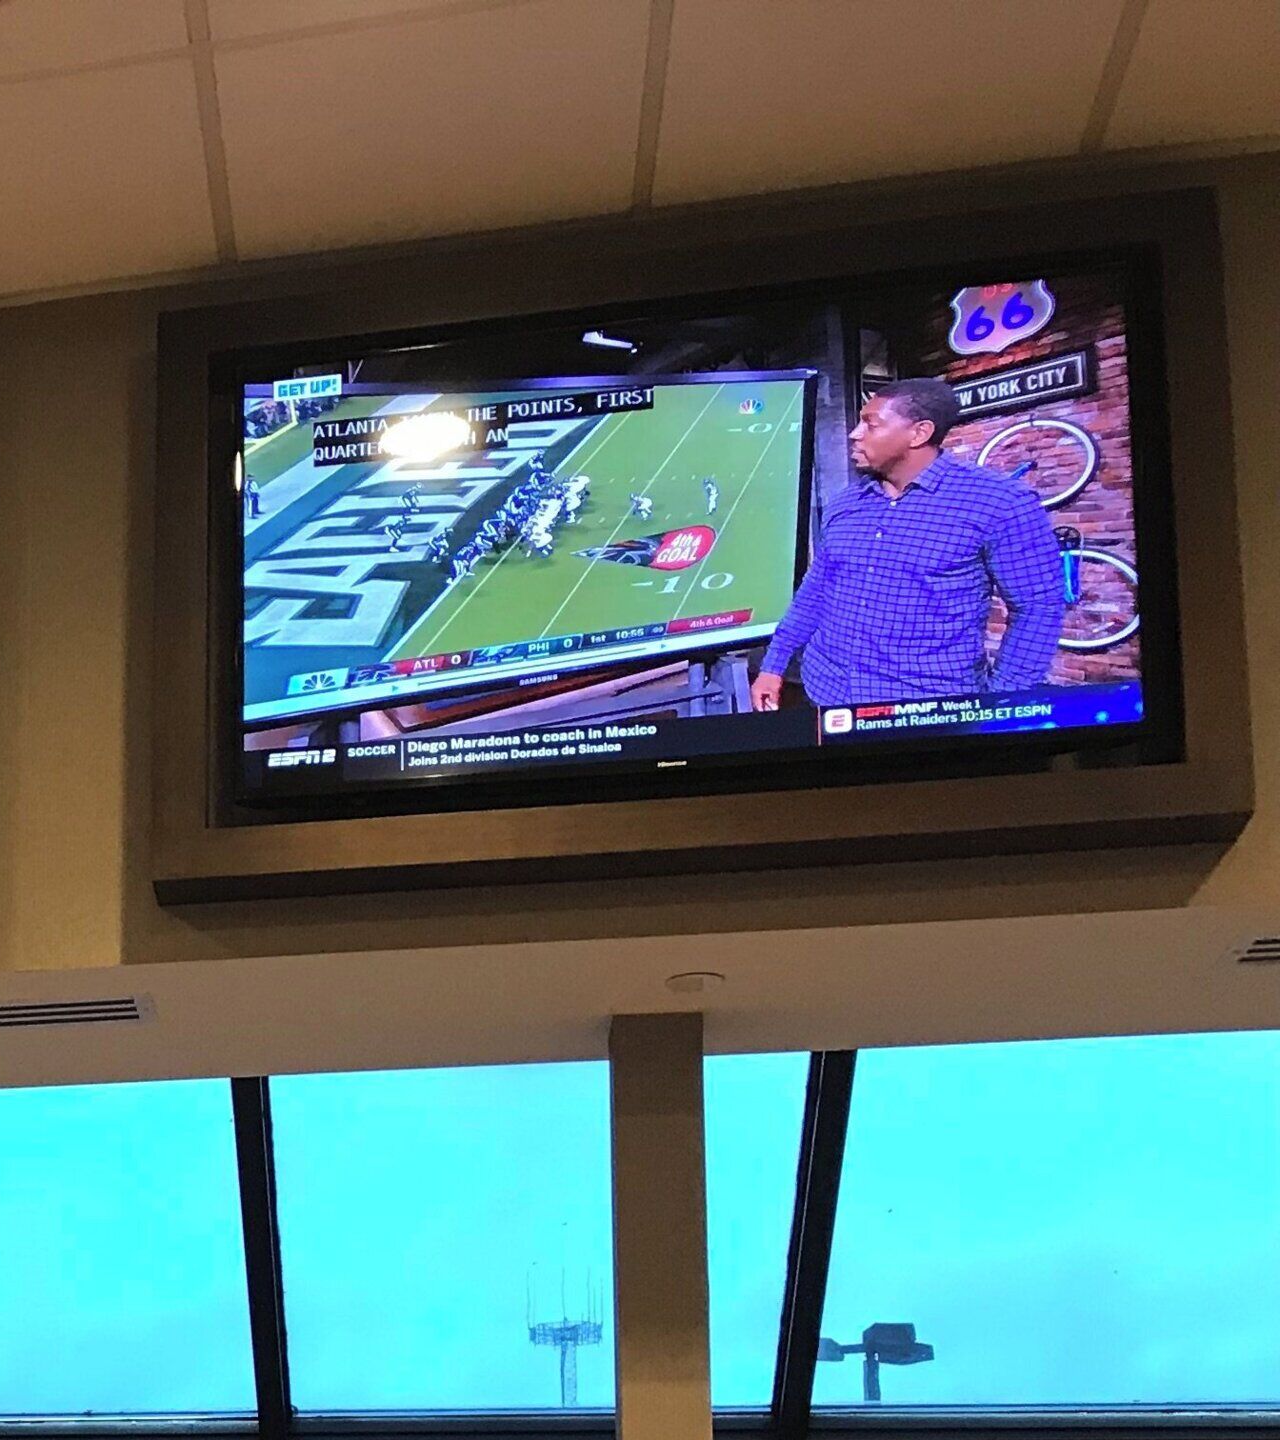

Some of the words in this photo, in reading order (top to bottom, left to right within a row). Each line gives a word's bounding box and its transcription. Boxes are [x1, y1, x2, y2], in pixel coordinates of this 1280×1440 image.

[965, 291, 1034, 342] 66
[278, 383, 307, 397] GET
[310, 378, 339, 393] UP!
[977, 379, 1021, 402] YORK
[1026, 366, 1067, 391] CITY
[313, 419, 389, 438] ATLANTA
[464, 405, 497, 422] THE
[507, 397, 584, 419] POINTS,
[597, 388, 654, 408] FIRST
[485, 428, 509, 443] AN
[656, 546, 698, 563] GOAL
[413, 658, 439, 671] ATL
[450, 654, 461, 665] 0
[528, 642, 550, 653] PHI
[563, 638, 573, 649] 0
[856, 719, 892, 731] Rams
[894, 716, 908, 728] at
[910, 713, 958, 726] Raiders
[961, 711, 994, 722] 10:15
[995, 709, 1012, 720] ET
[1015, 704, 1052, 717] ESPN
[895, 702, 938, 715] MNF
[942, 701, 972, 711] Week
[347, 744, 396, 757] SOCCER
[407, 739, 448, 755] Diego
[451, 734, 520, 749] Maradona
[524, 732, 539, 745] to
[542, 728, 585, 743] coach
[588, 726, 602, 739] in
[605, 723, 658, 738] Mexico
[408, 755, 438, 768] Joins
[440, 751, 462, 764] 2nd
[465, 749, 509, 763] division
[511, 746, 558, 760] Dorados
[561, 743, 576, 756] de
[578, 741, 622, 755] Sinaloa
